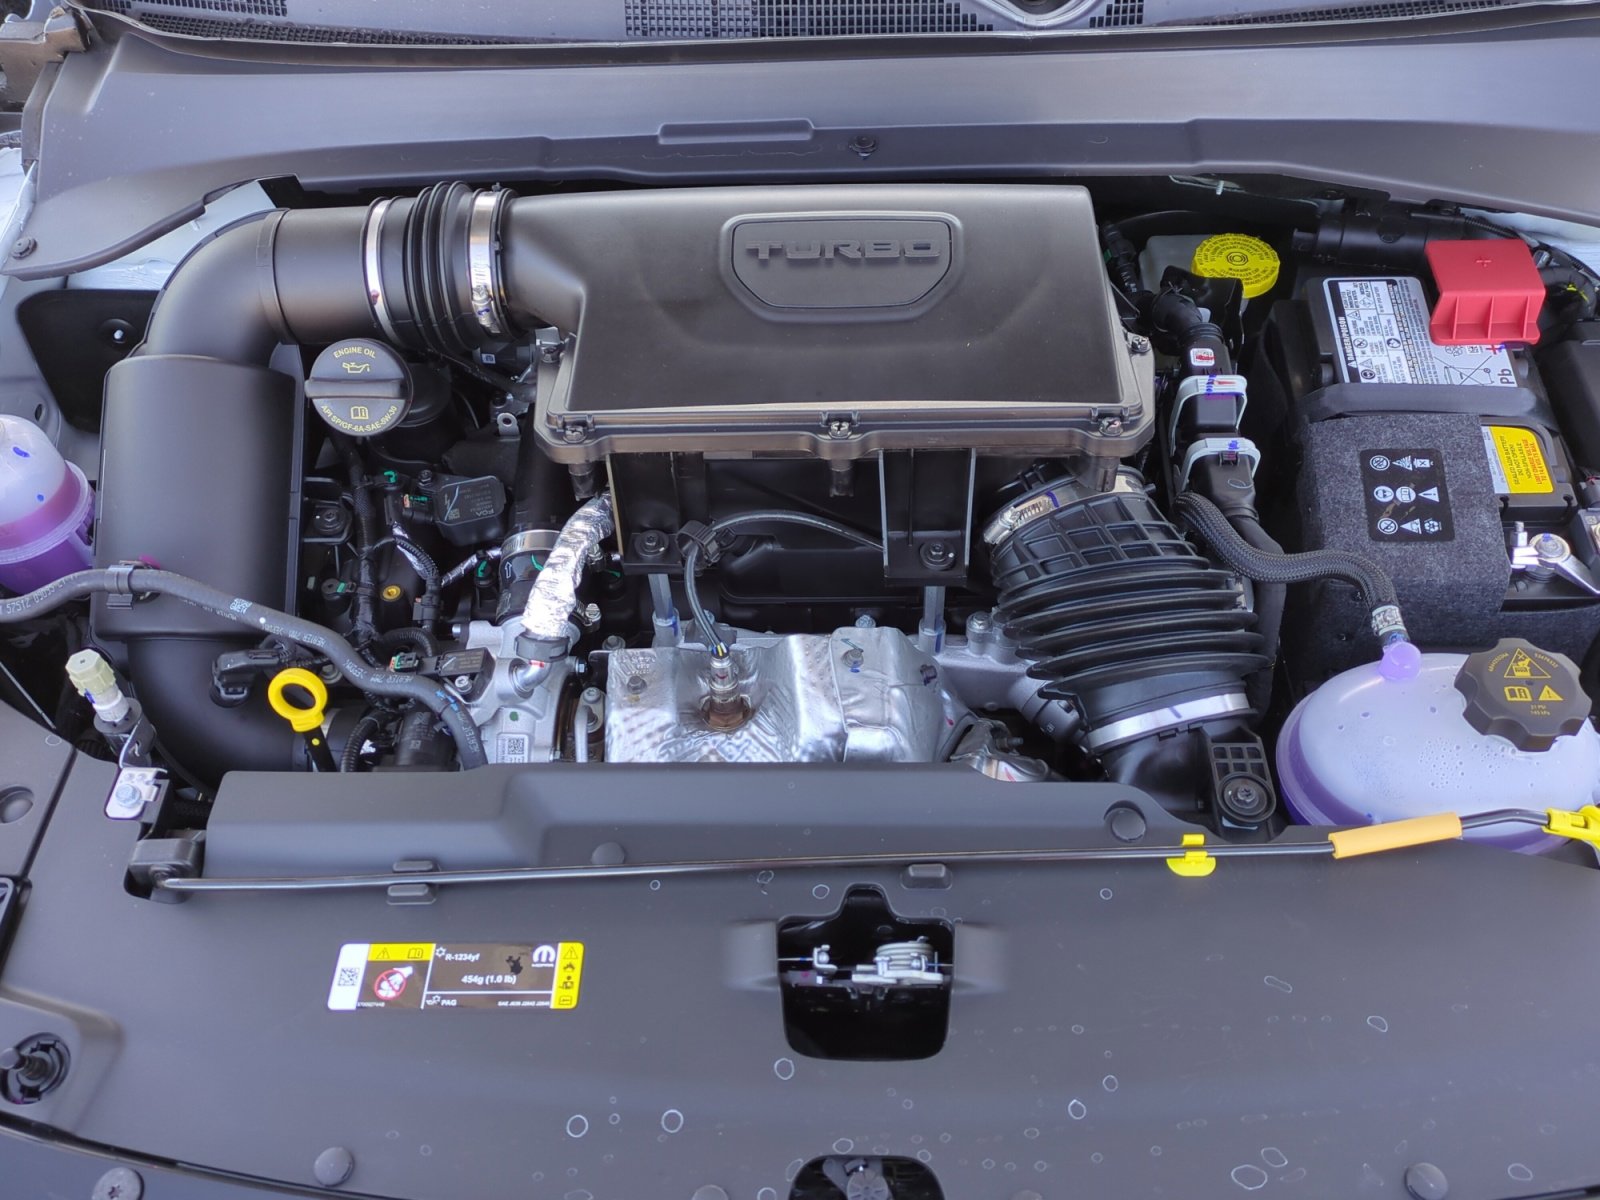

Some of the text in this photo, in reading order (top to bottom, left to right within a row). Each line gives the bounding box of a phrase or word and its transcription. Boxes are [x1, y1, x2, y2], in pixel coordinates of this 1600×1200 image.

[745, 239, 941, 260] TURBO
[333, 346, 376, 358] ENGINE OIL
[1498, 368, 1514, 384] Pb
[321, 405, 332, 418] API
[445, 953, 480, 962] R-1234yf
[461, 974, 517, 986] 454g (1.0 lb)
